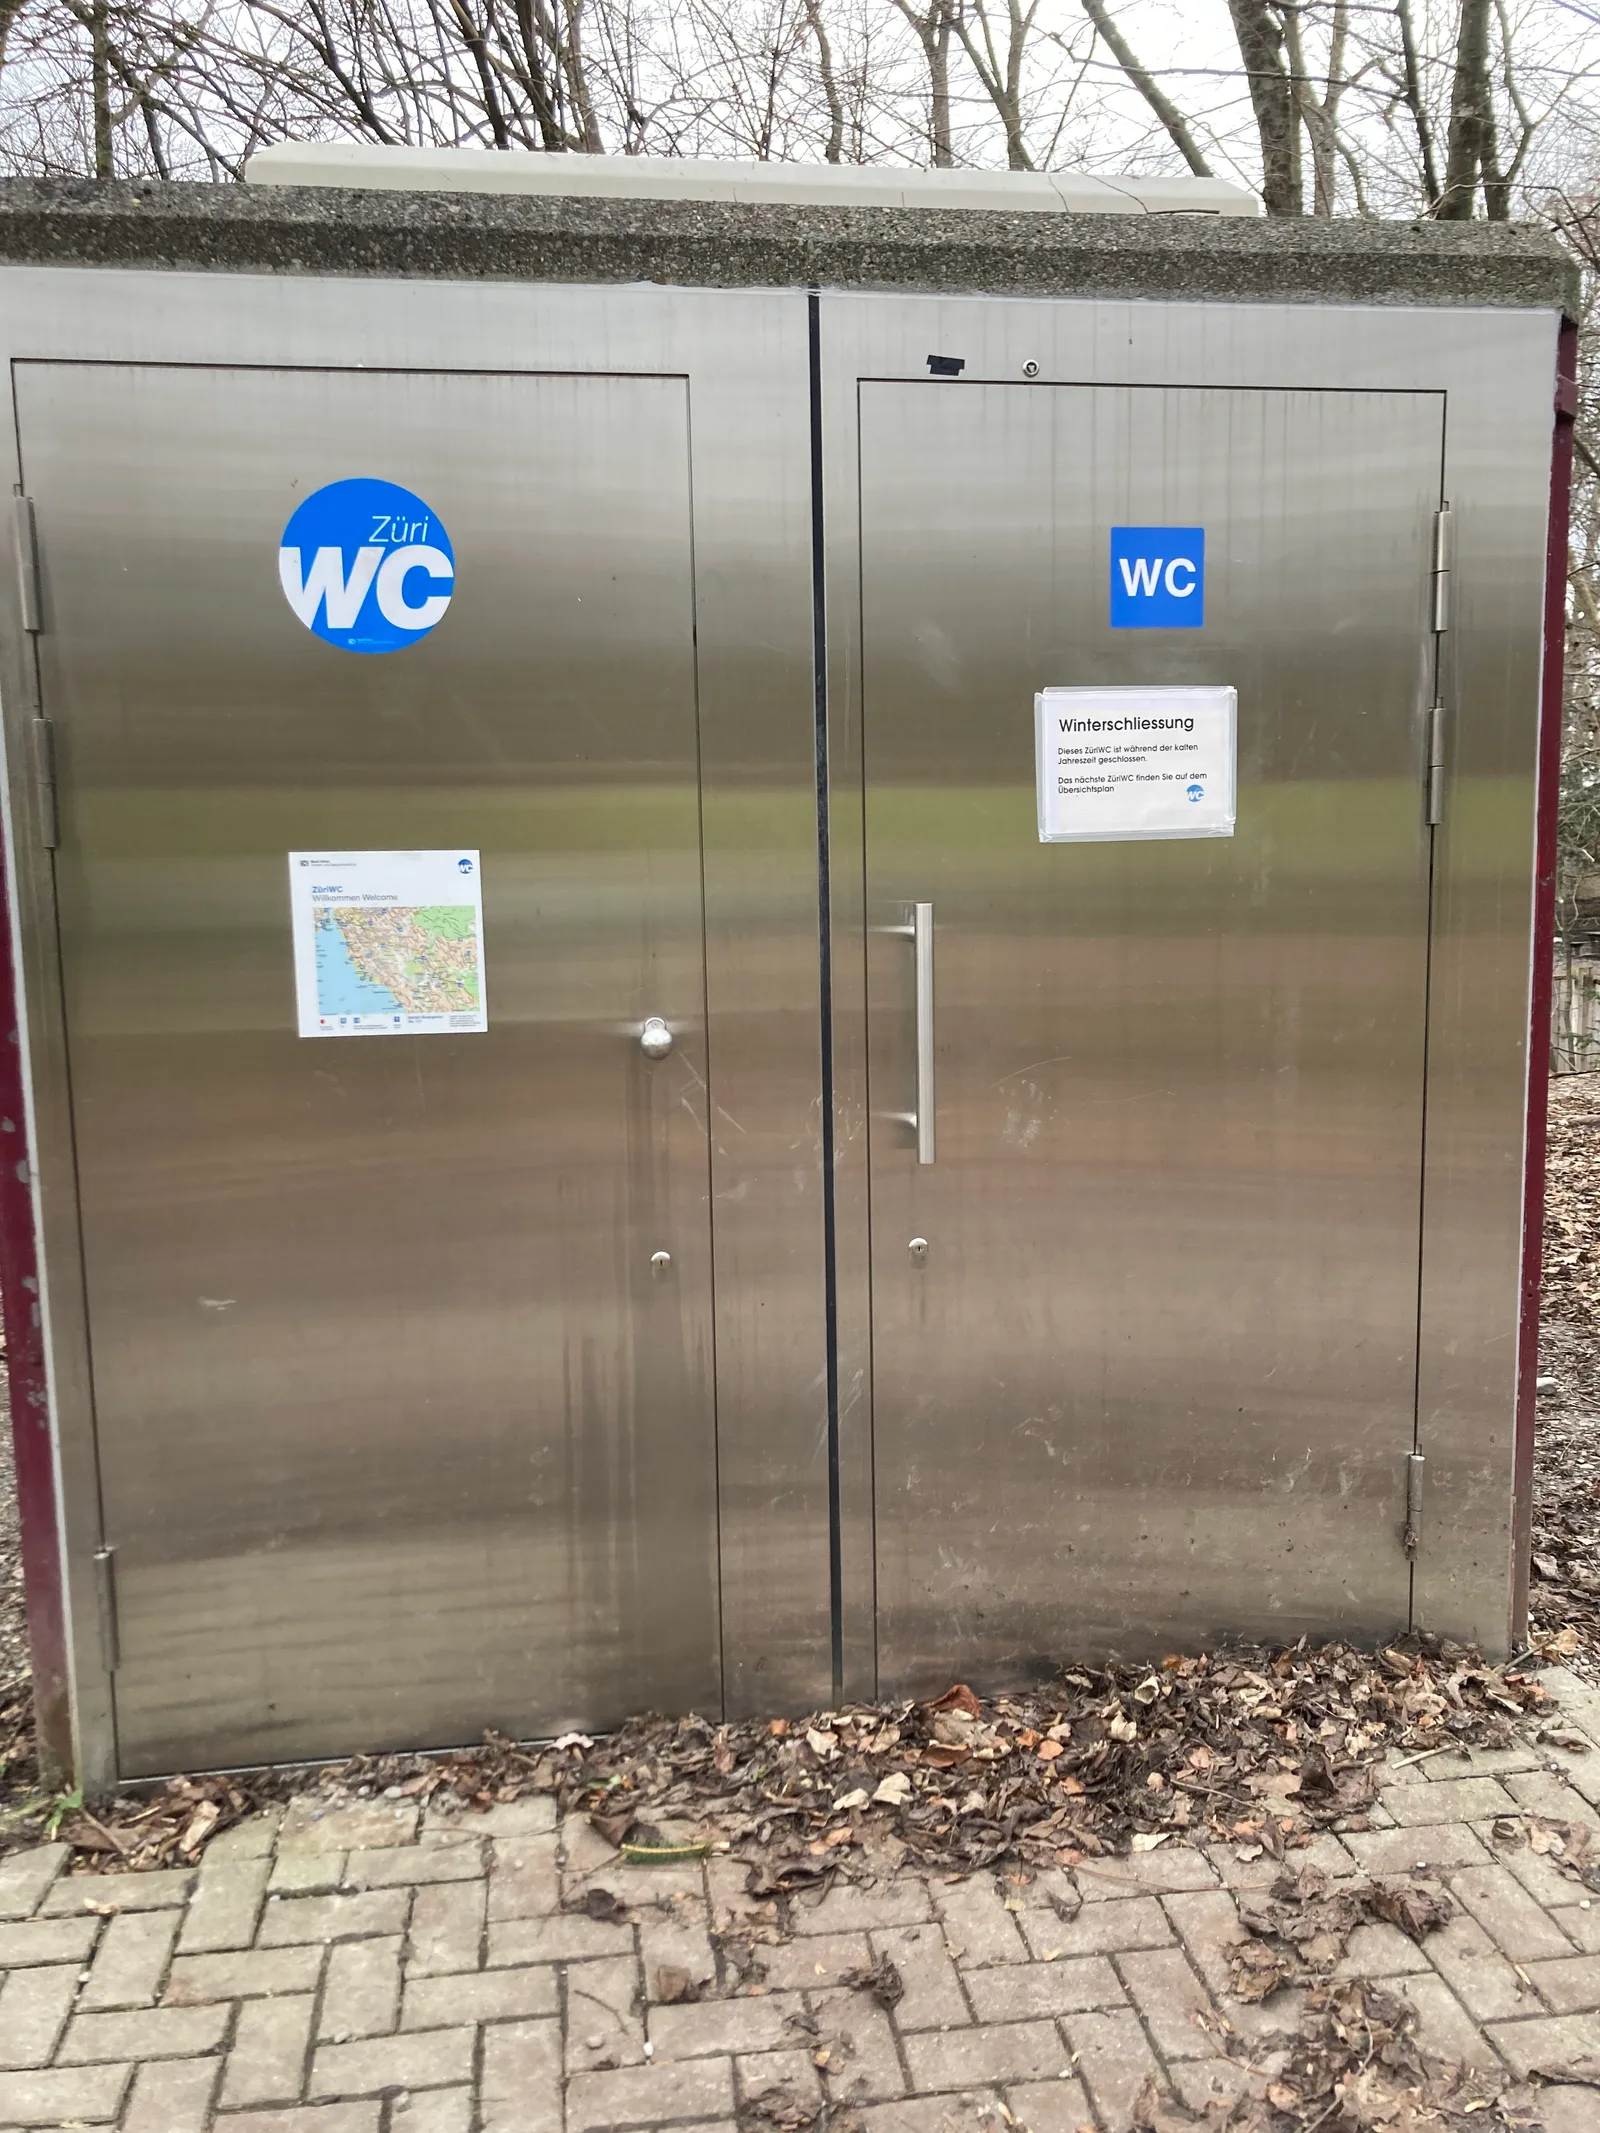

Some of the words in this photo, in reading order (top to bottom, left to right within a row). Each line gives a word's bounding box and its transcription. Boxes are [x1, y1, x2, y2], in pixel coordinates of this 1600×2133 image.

[368, 516, 429, 543] Züri
[1119, 558, 1196, 598] WC
[279, 545, 454, 630] WC
[1059, 716, 1194, 732] Winterschliessung
[1058, 747, 1083, 756] Dieses
[1084, 746, 1112, 754] ZüriWC
[1113, 745, 1122, 753] ist
[1123, 744, 1158, 753] während
[1159, 744, 1173, 752] der
[1174, 743, 1198, 751] kalten
[1058, 756, 1096, 765] Jahreszeit
[1098, 755, 1148, 765] geschlossen.
[1058, 776, 1073, 784] Das
[1074, 775, 1105, 784] nächste
[1107, 774, 1135, 782] ZüriWC
[1136, 773, 1160, 781] finden
[1175, 772, 1188, 780] auf
[1189, 772, 1208, 780] dem
[1058, 785, 1115, 794] Übersichtsplan
[312, 885, 343, 893] ZüriWC
[312, 894, 361, 902] Willkommen
[362, 893, 398, 901] Welcome
